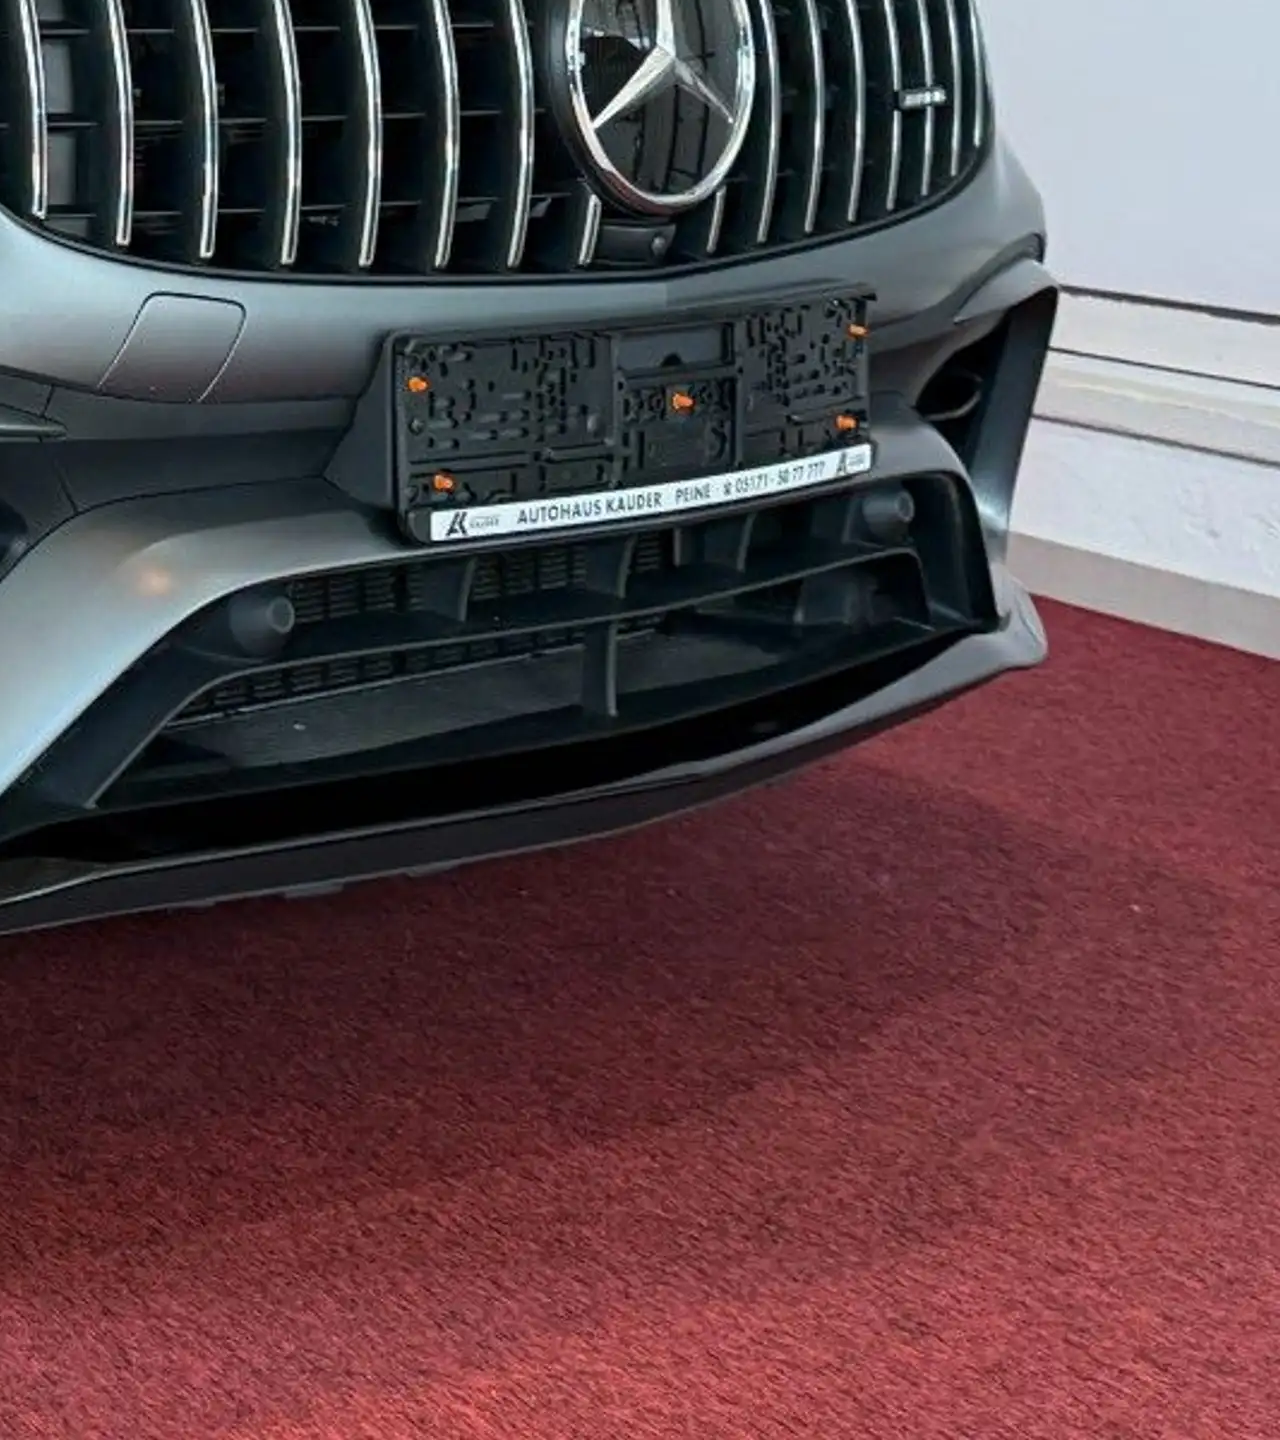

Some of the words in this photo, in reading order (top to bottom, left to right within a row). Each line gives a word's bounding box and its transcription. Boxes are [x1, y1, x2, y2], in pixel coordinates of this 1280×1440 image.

[517, 498, 602, 525] AUTOHAUS
[605, 491, 663, 513] KAUDER
[674, 483, 710, 505] PEINE
